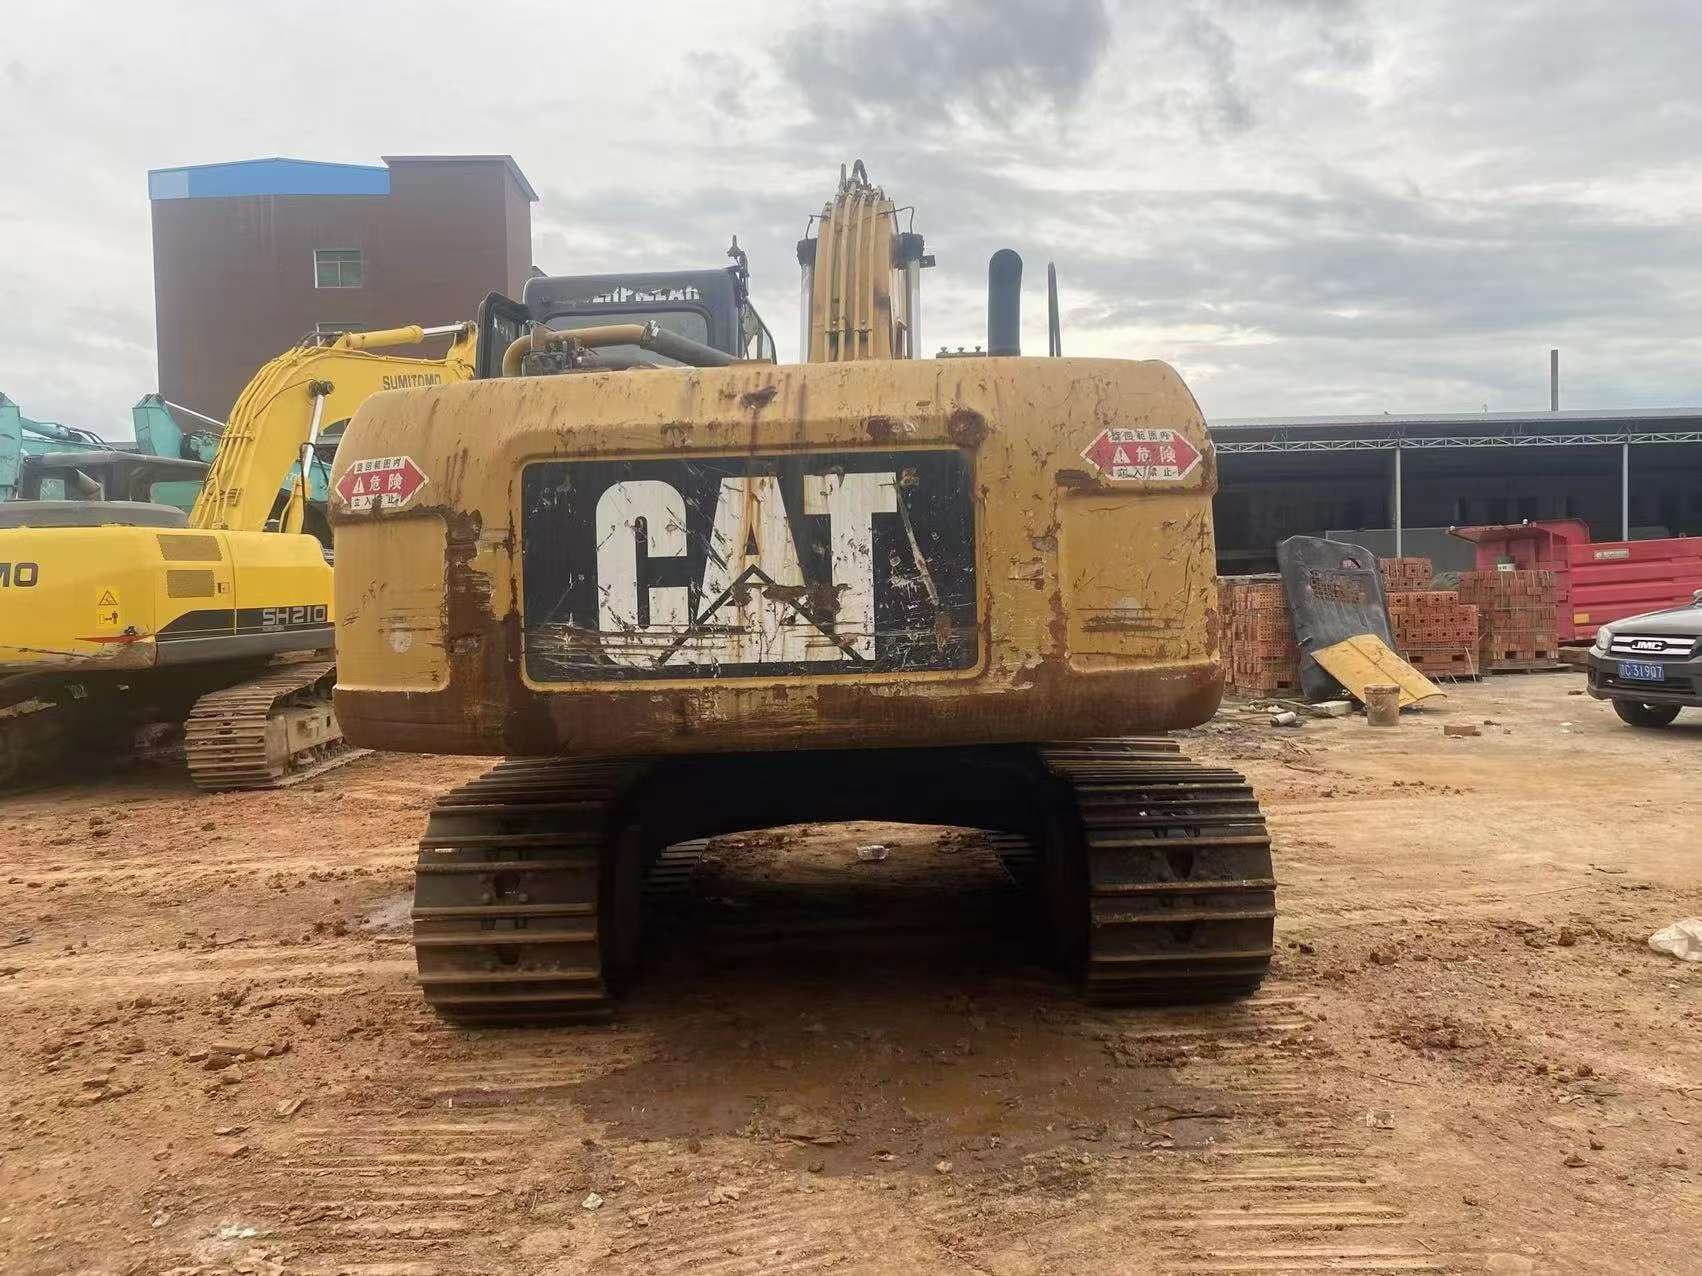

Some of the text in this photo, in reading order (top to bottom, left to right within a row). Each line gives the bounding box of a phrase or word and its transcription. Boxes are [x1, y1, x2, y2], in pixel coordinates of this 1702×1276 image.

[383, 374, 441, 390] SUMITOMO
[596, 471, 898, 667] CAT
[262, 606, 326, 625] SH210
[1631, 640, 1663, 650] JMC
